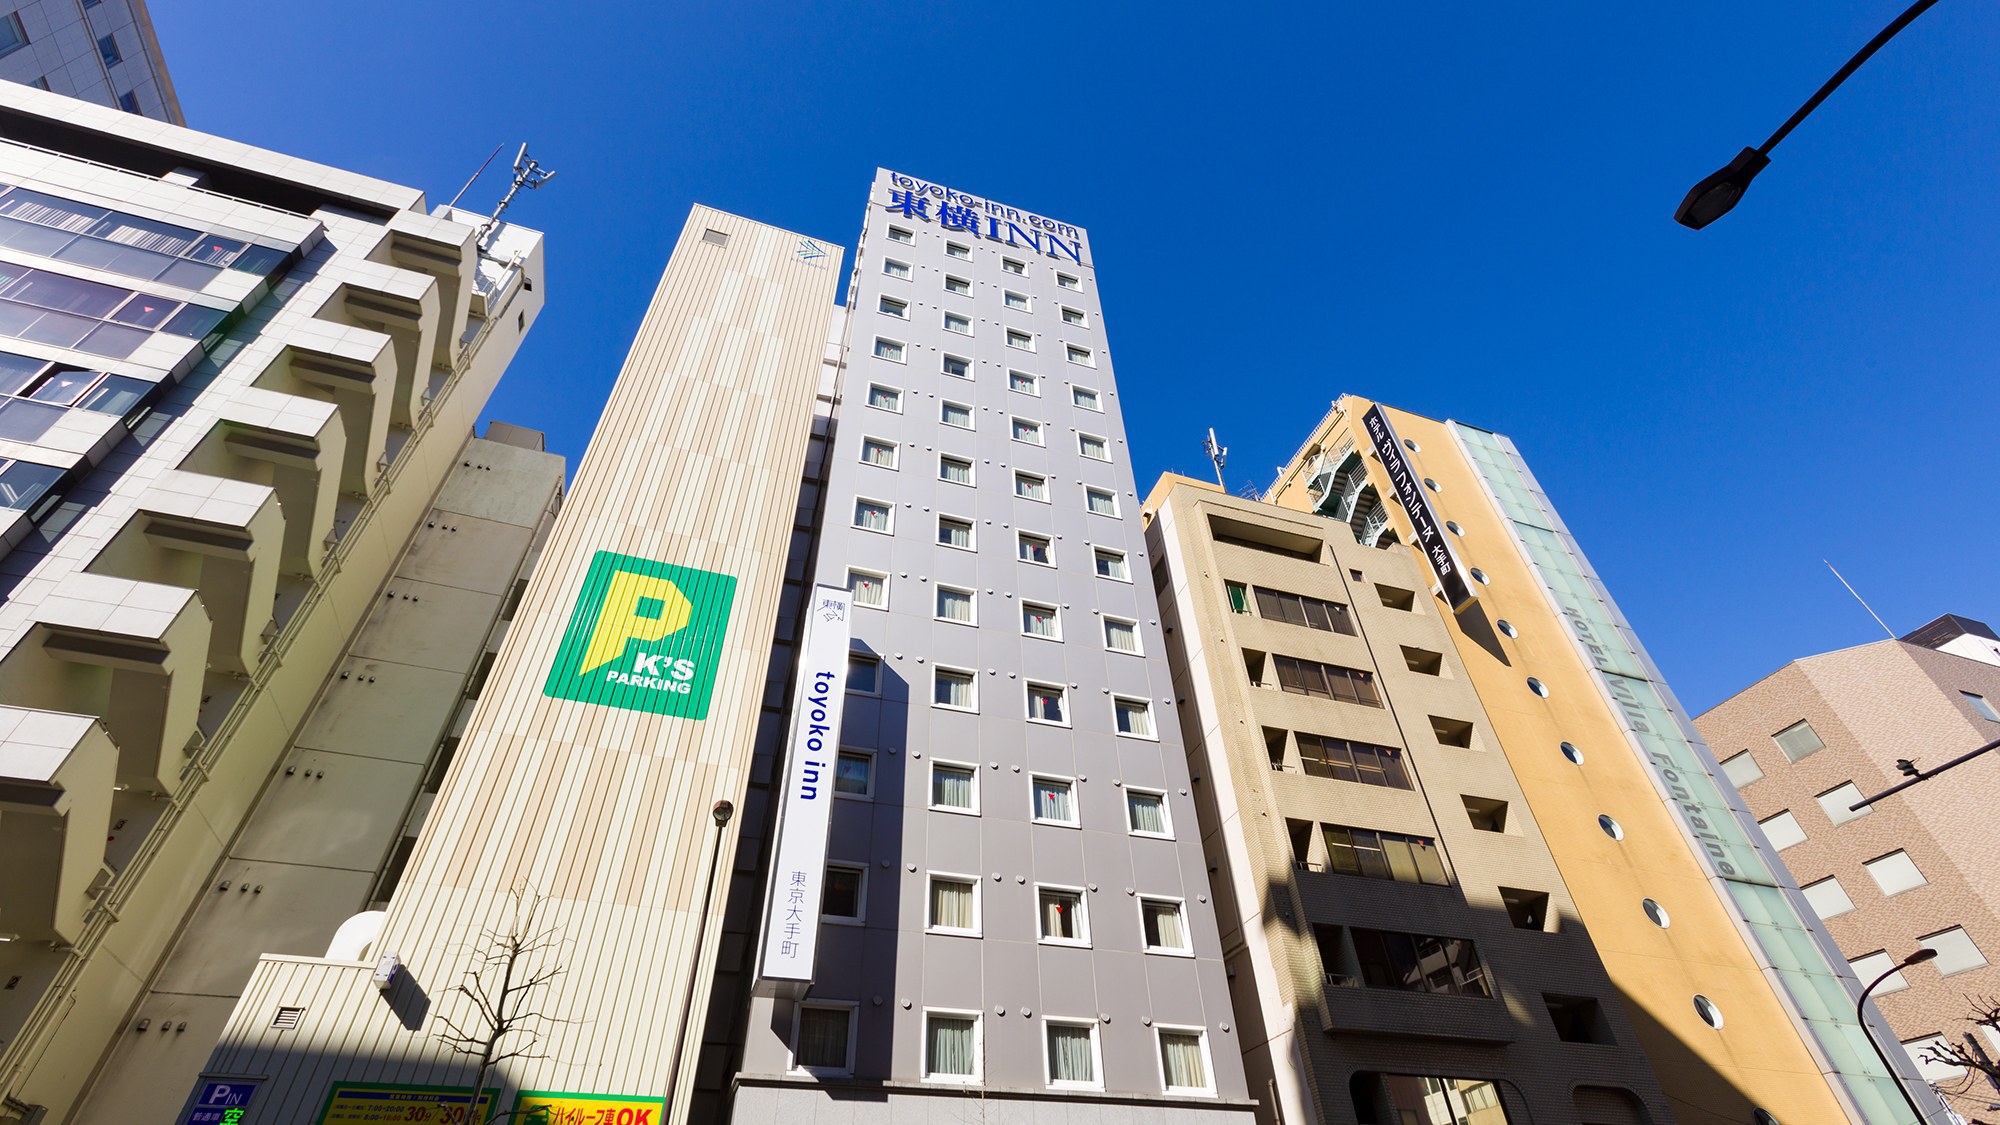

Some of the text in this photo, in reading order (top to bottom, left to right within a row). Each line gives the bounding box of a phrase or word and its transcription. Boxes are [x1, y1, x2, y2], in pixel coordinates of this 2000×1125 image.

[890, 171, 1080, 240] toyoko-inn.com
[1368, 415, 1385, 442] ホテル
[1431, 544, 1452, 576] 大手町
[579, 570, 693, 676] P
[633, 652, 695, 681] K'S
[605, 671, 692, 694] PARKING
[800, 671, 836, 800] toyoko inn
[1565, 605, 1736, 876] HOTEL Villa Fontaine
[781, 871, 807, 958] 東京大手町
[219, 1107, 245, 1125] 空
